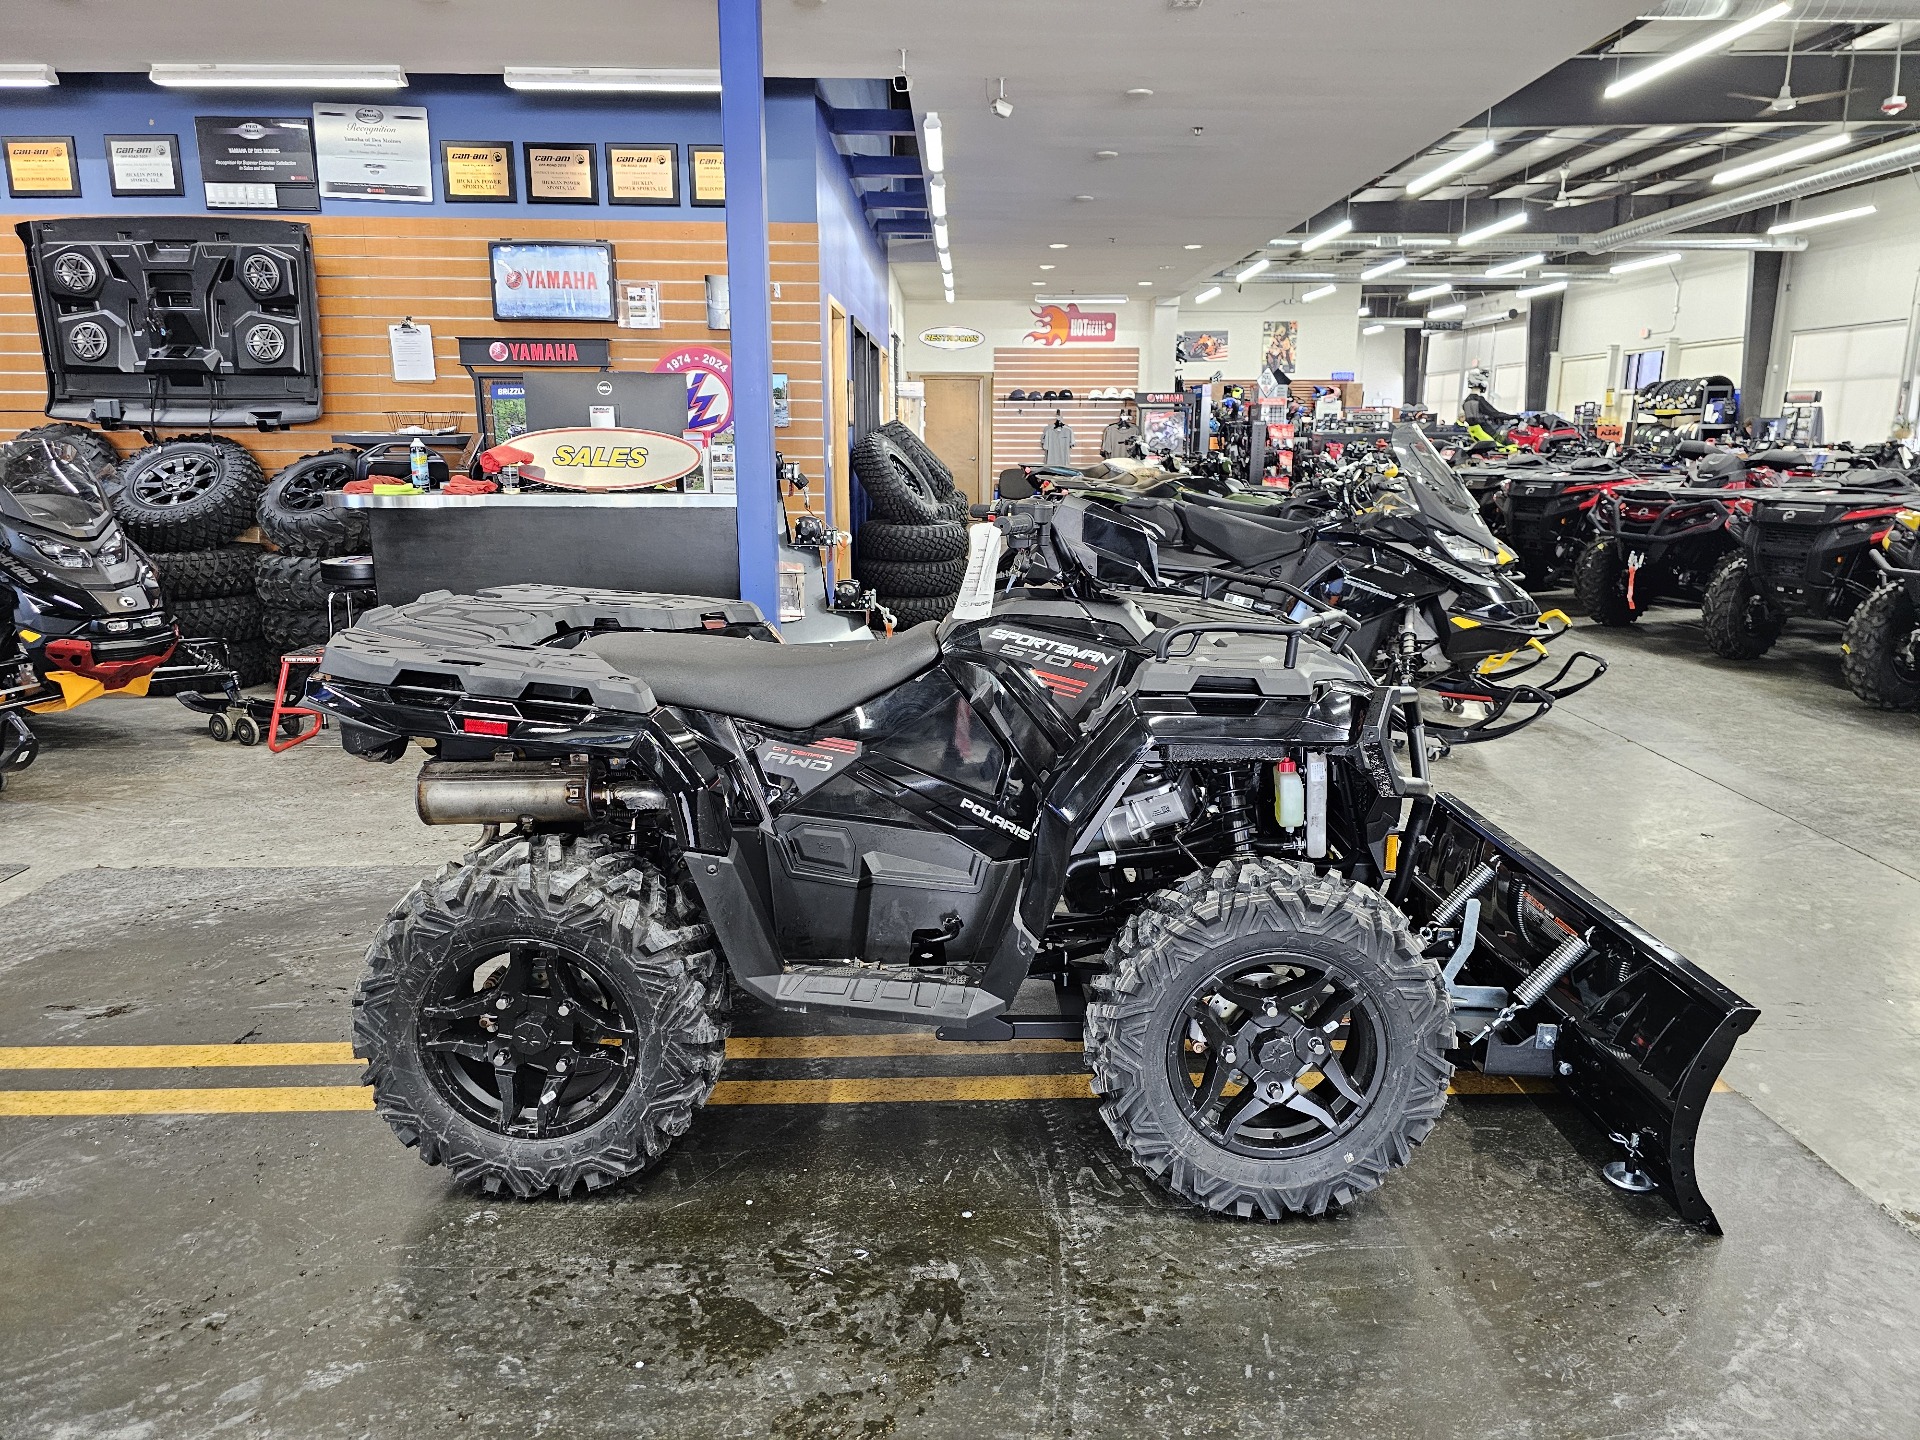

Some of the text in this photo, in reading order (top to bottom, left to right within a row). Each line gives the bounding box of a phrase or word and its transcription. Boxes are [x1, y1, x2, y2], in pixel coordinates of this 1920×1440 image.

[525, 270, 597, 291] YAMAHA
[1070, 318, 1089, 337] HOT
[924, 333, 979, 343] RESTROOMS
[508, 343, 578, 362] YAMAHA
[666, 353, 691, 372] 1974
[702, 353, 729, 373] 2024
[1154, 393, 1184, 403] YAMAHA
[552, 445, 649, 469] SALES
[988, 628, 1116, 666] SPORTSMAN
[999, 643, 1072, 668] 570
[763, 751, 833, 773] AWD
[790, 749, 834, 761] DEMAND
[959, 797, 1032, 842] POLARIS
